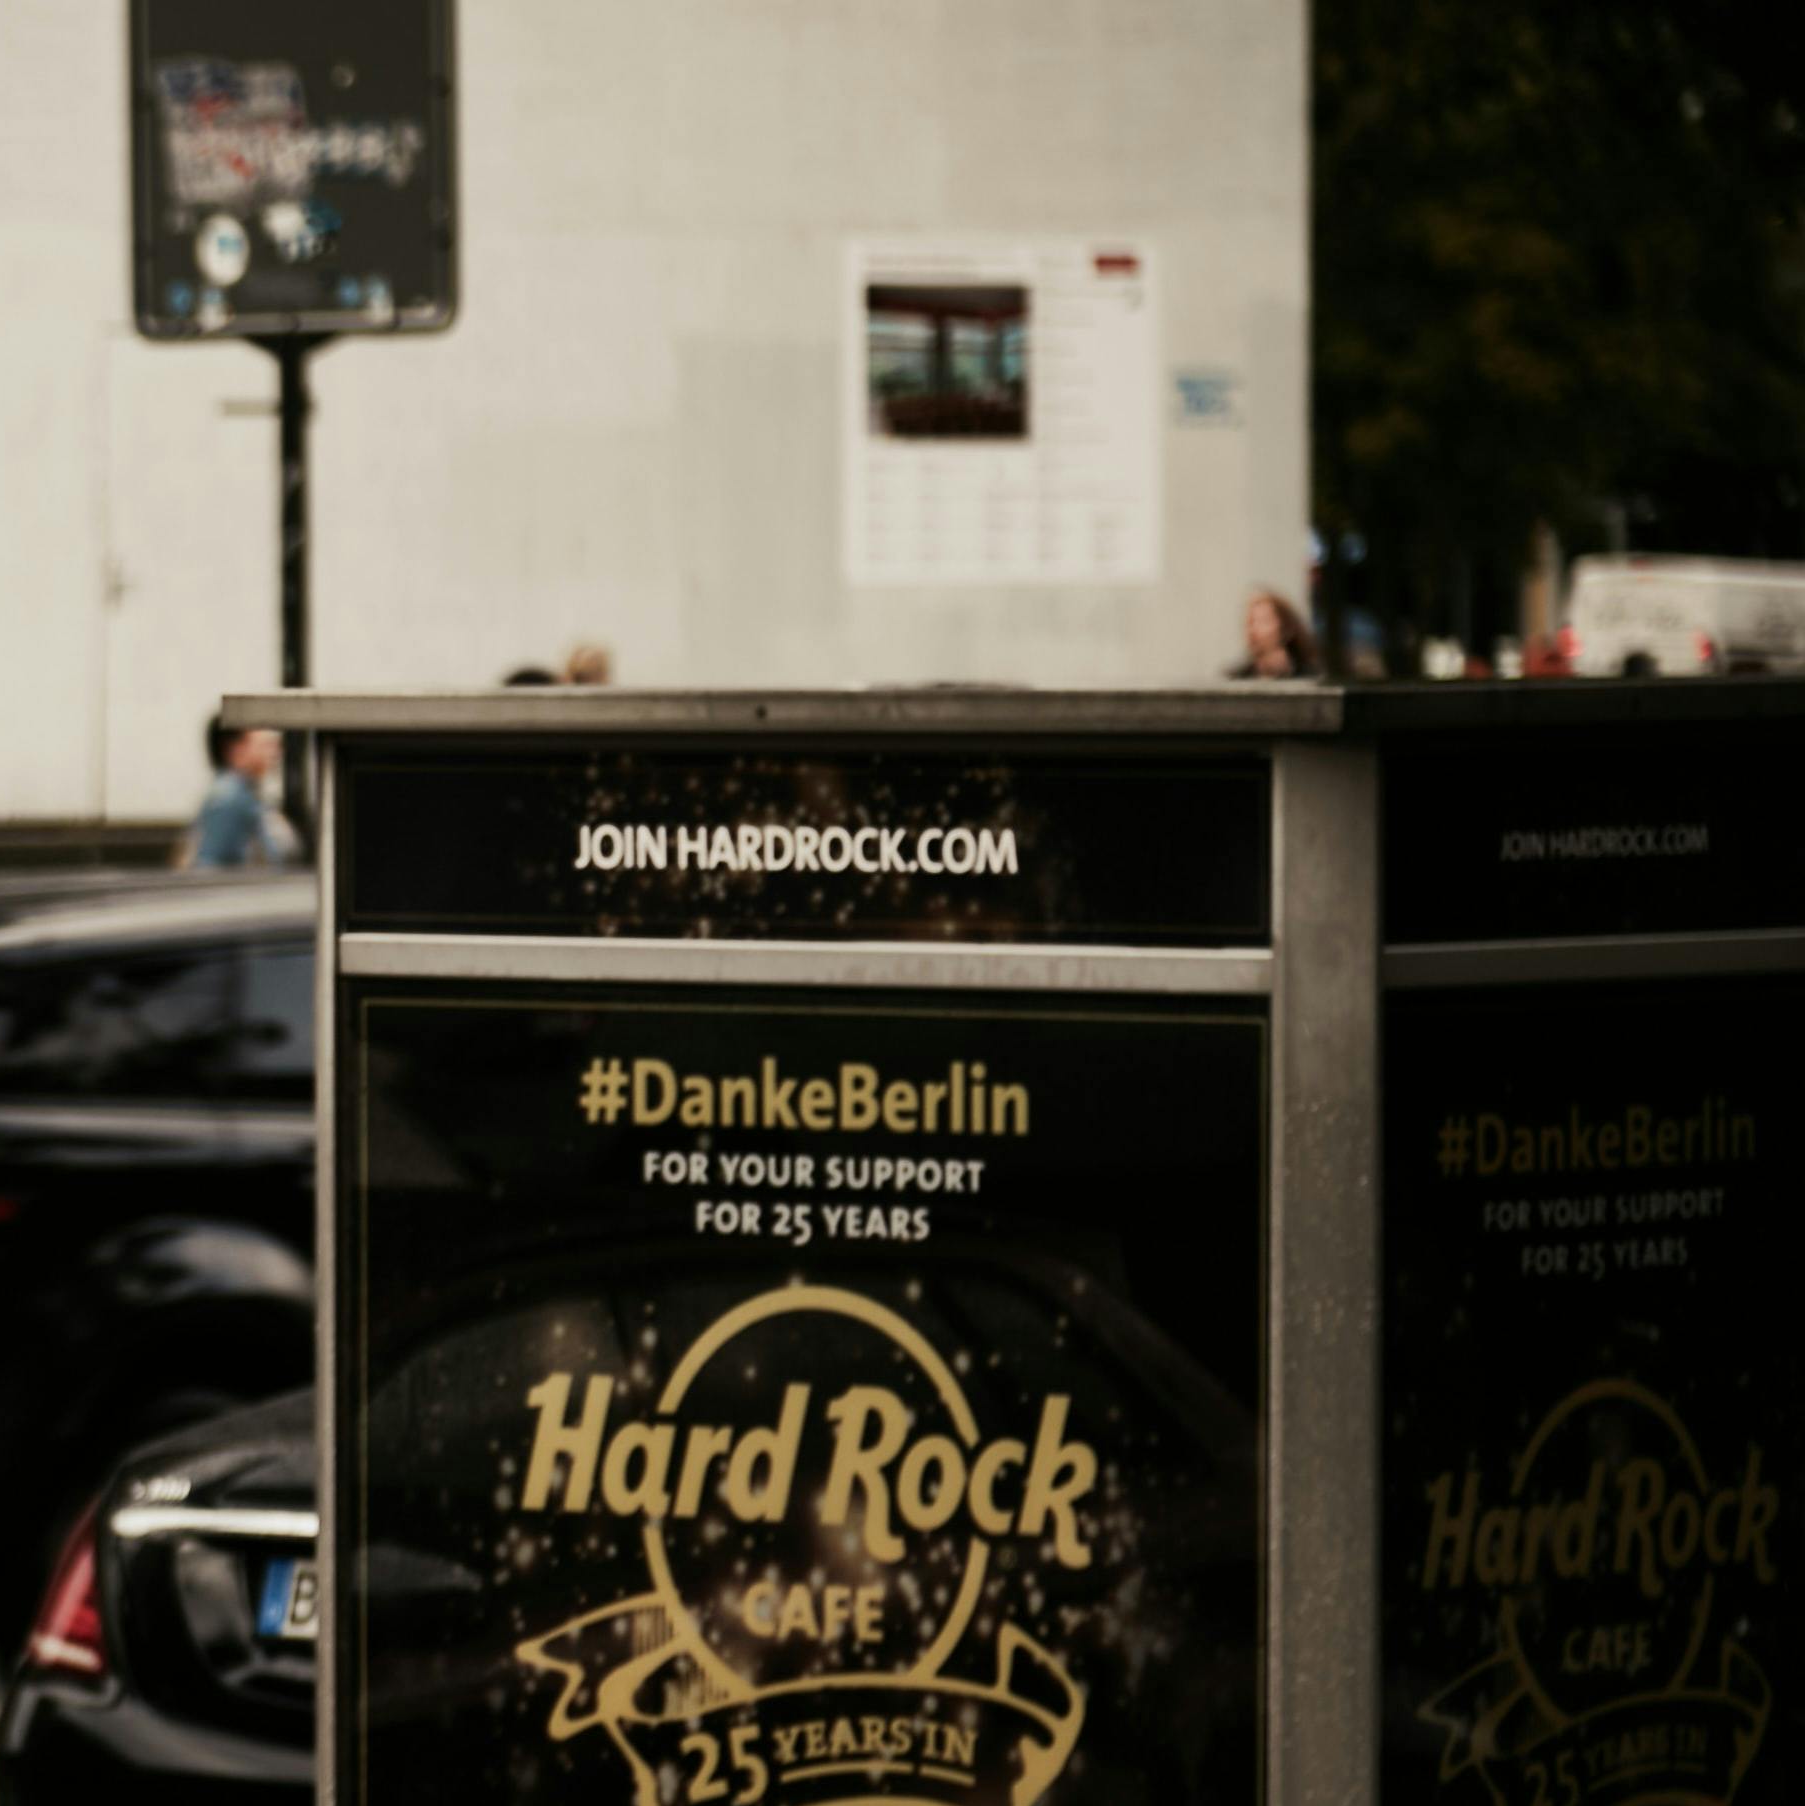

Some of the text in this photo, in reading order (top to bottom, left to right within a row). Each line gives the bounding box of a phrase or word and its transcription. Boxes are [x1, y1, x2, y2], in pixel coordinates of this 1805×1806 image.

[574, 823, 1020, 876] JOIN HARDROCK.COM
[1500, 822, 1710, 862] JOIN HARDROCK.COM
[580, 1056, 1030, 1135] #DankeBerlin
[1435, 1096, 1758, 1180] #DankeBerlin
[643, 1151, 985, 1193] FOR YOUR SUPPORT
[695, 1200, 931, 1247] FOR 25 YEARS
[1483, 1186, 1726, 1232] FOR YOUR SUPPORT
[1520, 1236, 1690, 1284] FOR 25 YEARS
[520, 1371, 1100, 1571] Hard Rock
[1421, 1440, 1780, 1600] Hard Rock
[742, 1582, 887, 1645] CAFE
[1560, 1622, 1654, 1678] CAFE
[771, 1714, 914, 1768] YEARS
[921, 1720, 979, 1768] IN
